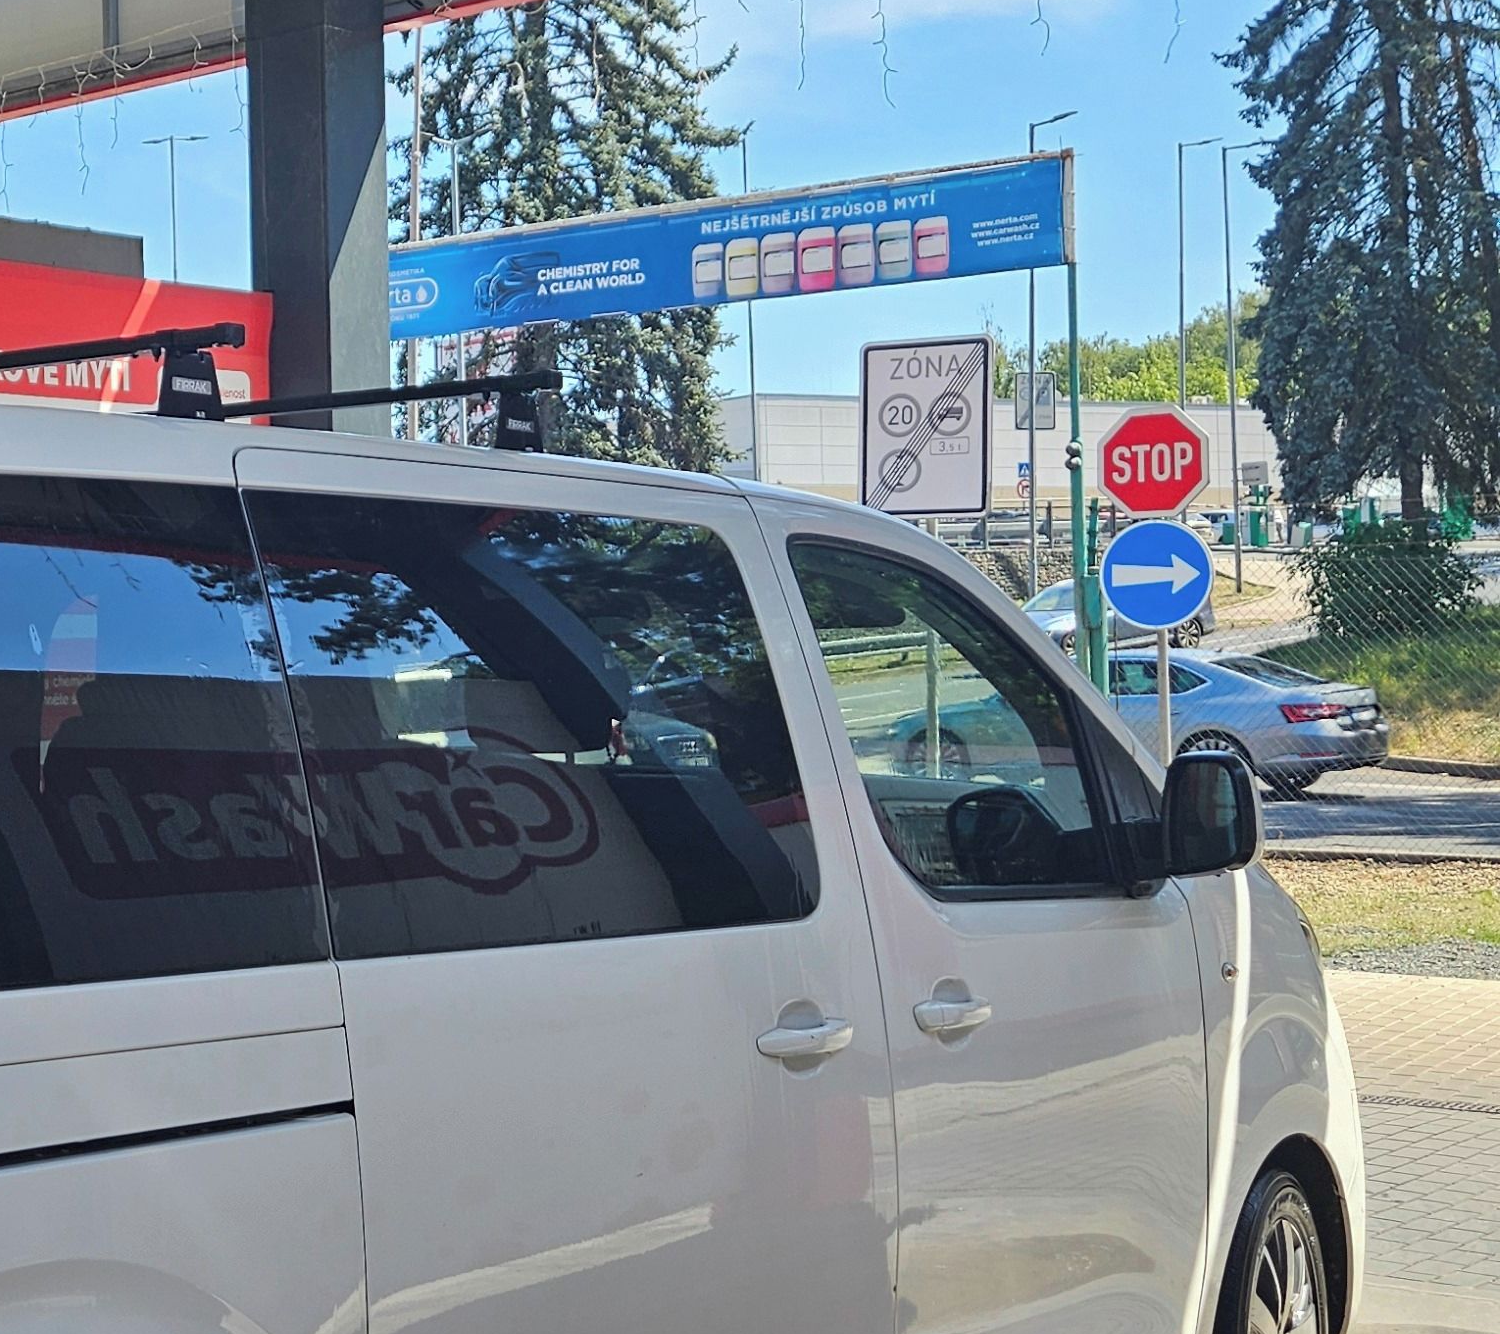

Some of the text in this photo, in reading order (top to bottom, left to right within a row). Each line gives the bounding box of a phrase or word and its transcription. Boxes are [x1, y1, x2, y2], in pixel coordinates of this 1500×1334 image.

[821, 200, 888, 219] ZPŮSOB
[894, 189, 936, 211] MYTÍ
[971, 222, 1040, 238] www.carwash.cz
[972, 213, 1038, 228] www.nerta.com
[977, 232, 1034, 247] www.nerta.cz
[538, 258, 640, 282] CHEMISTRY FOR
[537, 272, 645, 296] A CLEAN WORLD
[890, 349, 961, 380] ZÓNA
[175, 378, 207, 393] FIRRAK
[888, 405, 913, 425] 20
[1111, 441, 1194, 484] STOP
